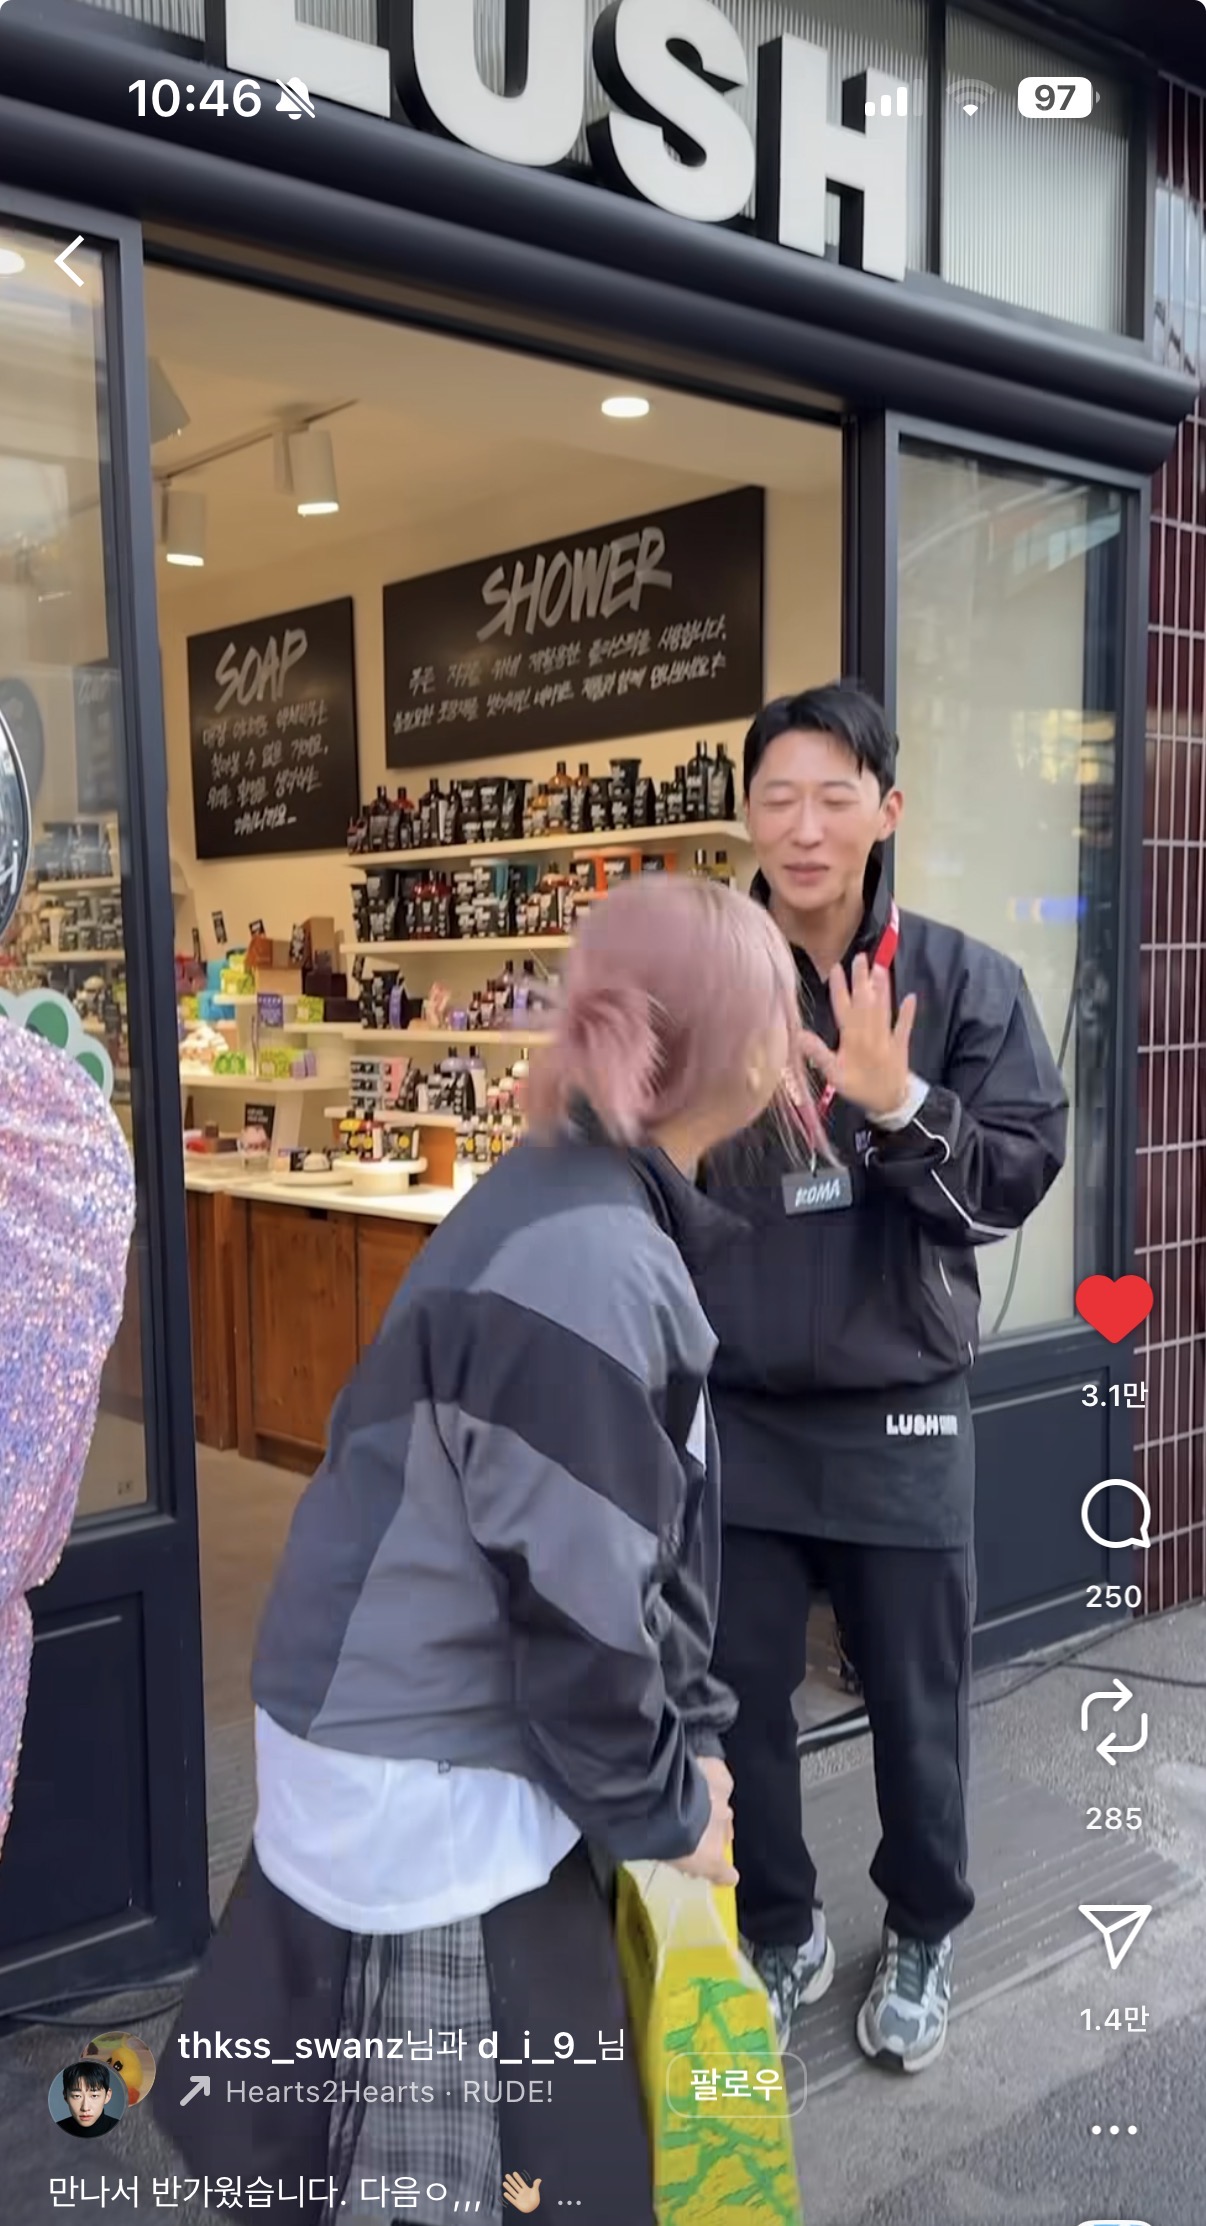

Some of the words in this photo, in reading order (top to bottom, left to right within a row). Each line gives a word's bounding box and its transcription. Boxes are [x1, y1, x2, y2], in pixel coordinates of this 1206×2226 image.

[476, 526, 673, 642] SHOWER
[658, 614, 726, 651] 사용합니다.
[214, 628, 308, 714] SOAP
[245, 747, 256, 771] 수
[274, 764, 322, 798] 생각하는
